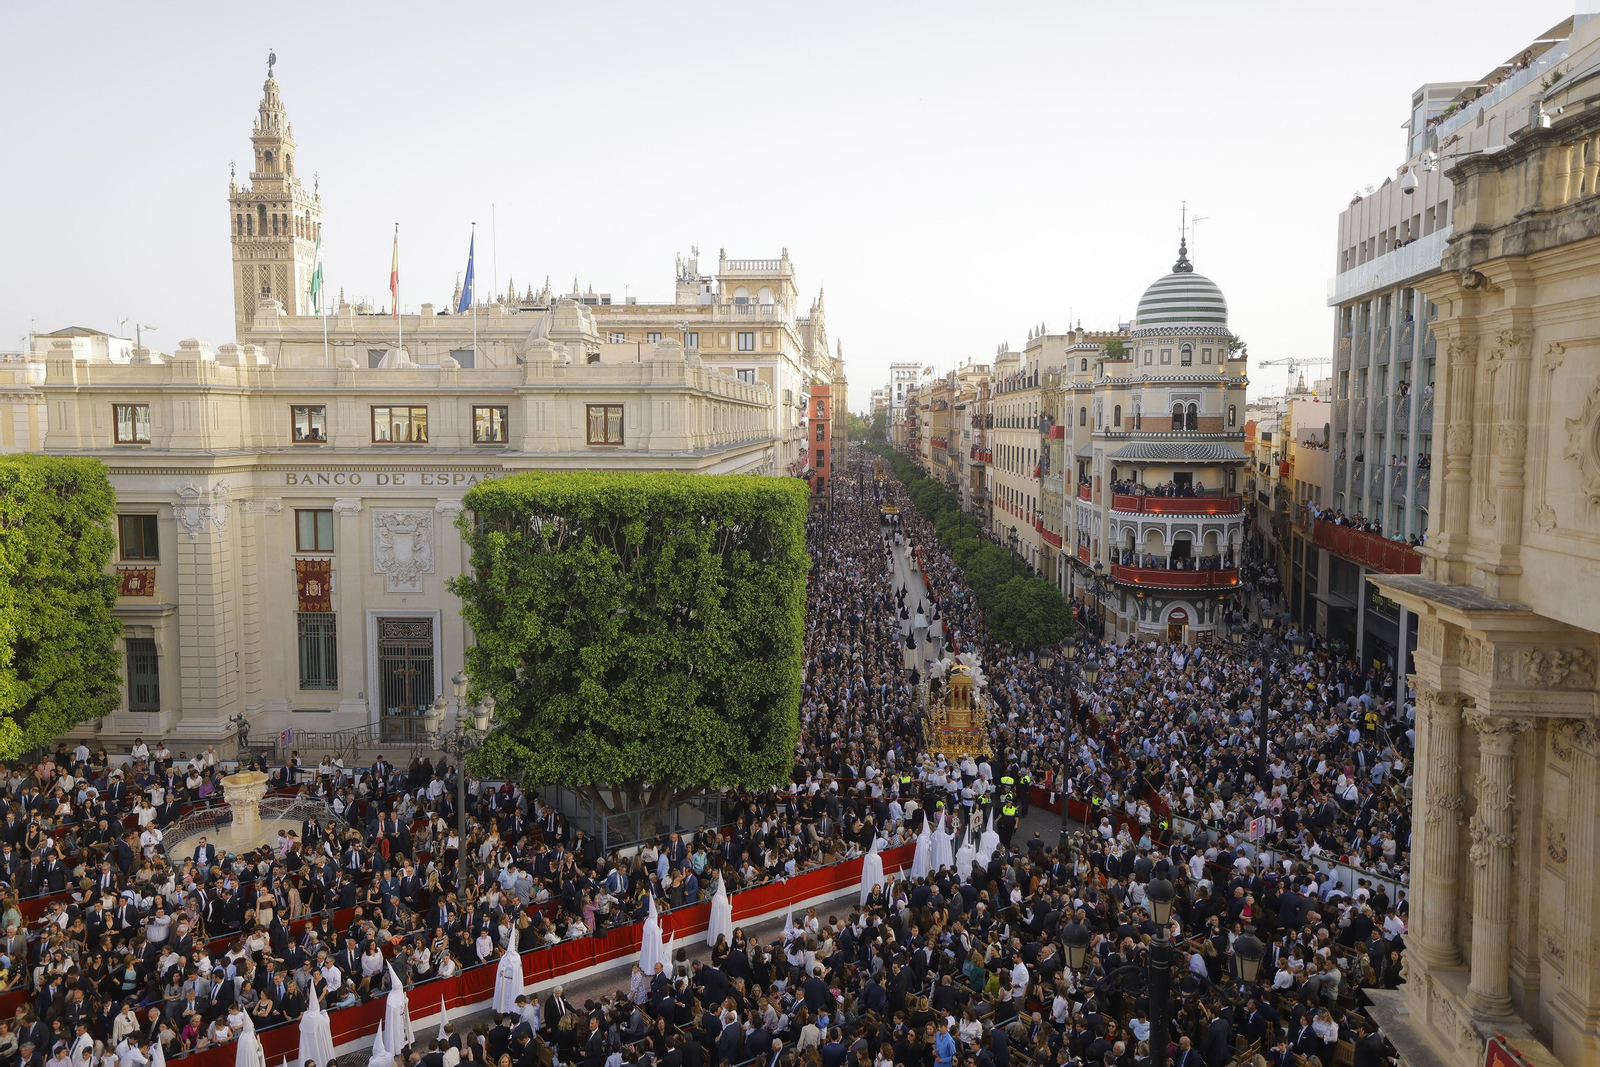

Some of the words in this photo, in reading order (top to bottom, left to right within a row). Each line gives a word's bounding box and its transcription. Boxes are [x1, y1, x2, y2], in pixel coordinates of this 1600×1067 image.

[285, 472, 362, 485] BANCO
[376, 473, 405, 486] DE
[420, 472, 507, 486] ESPA
